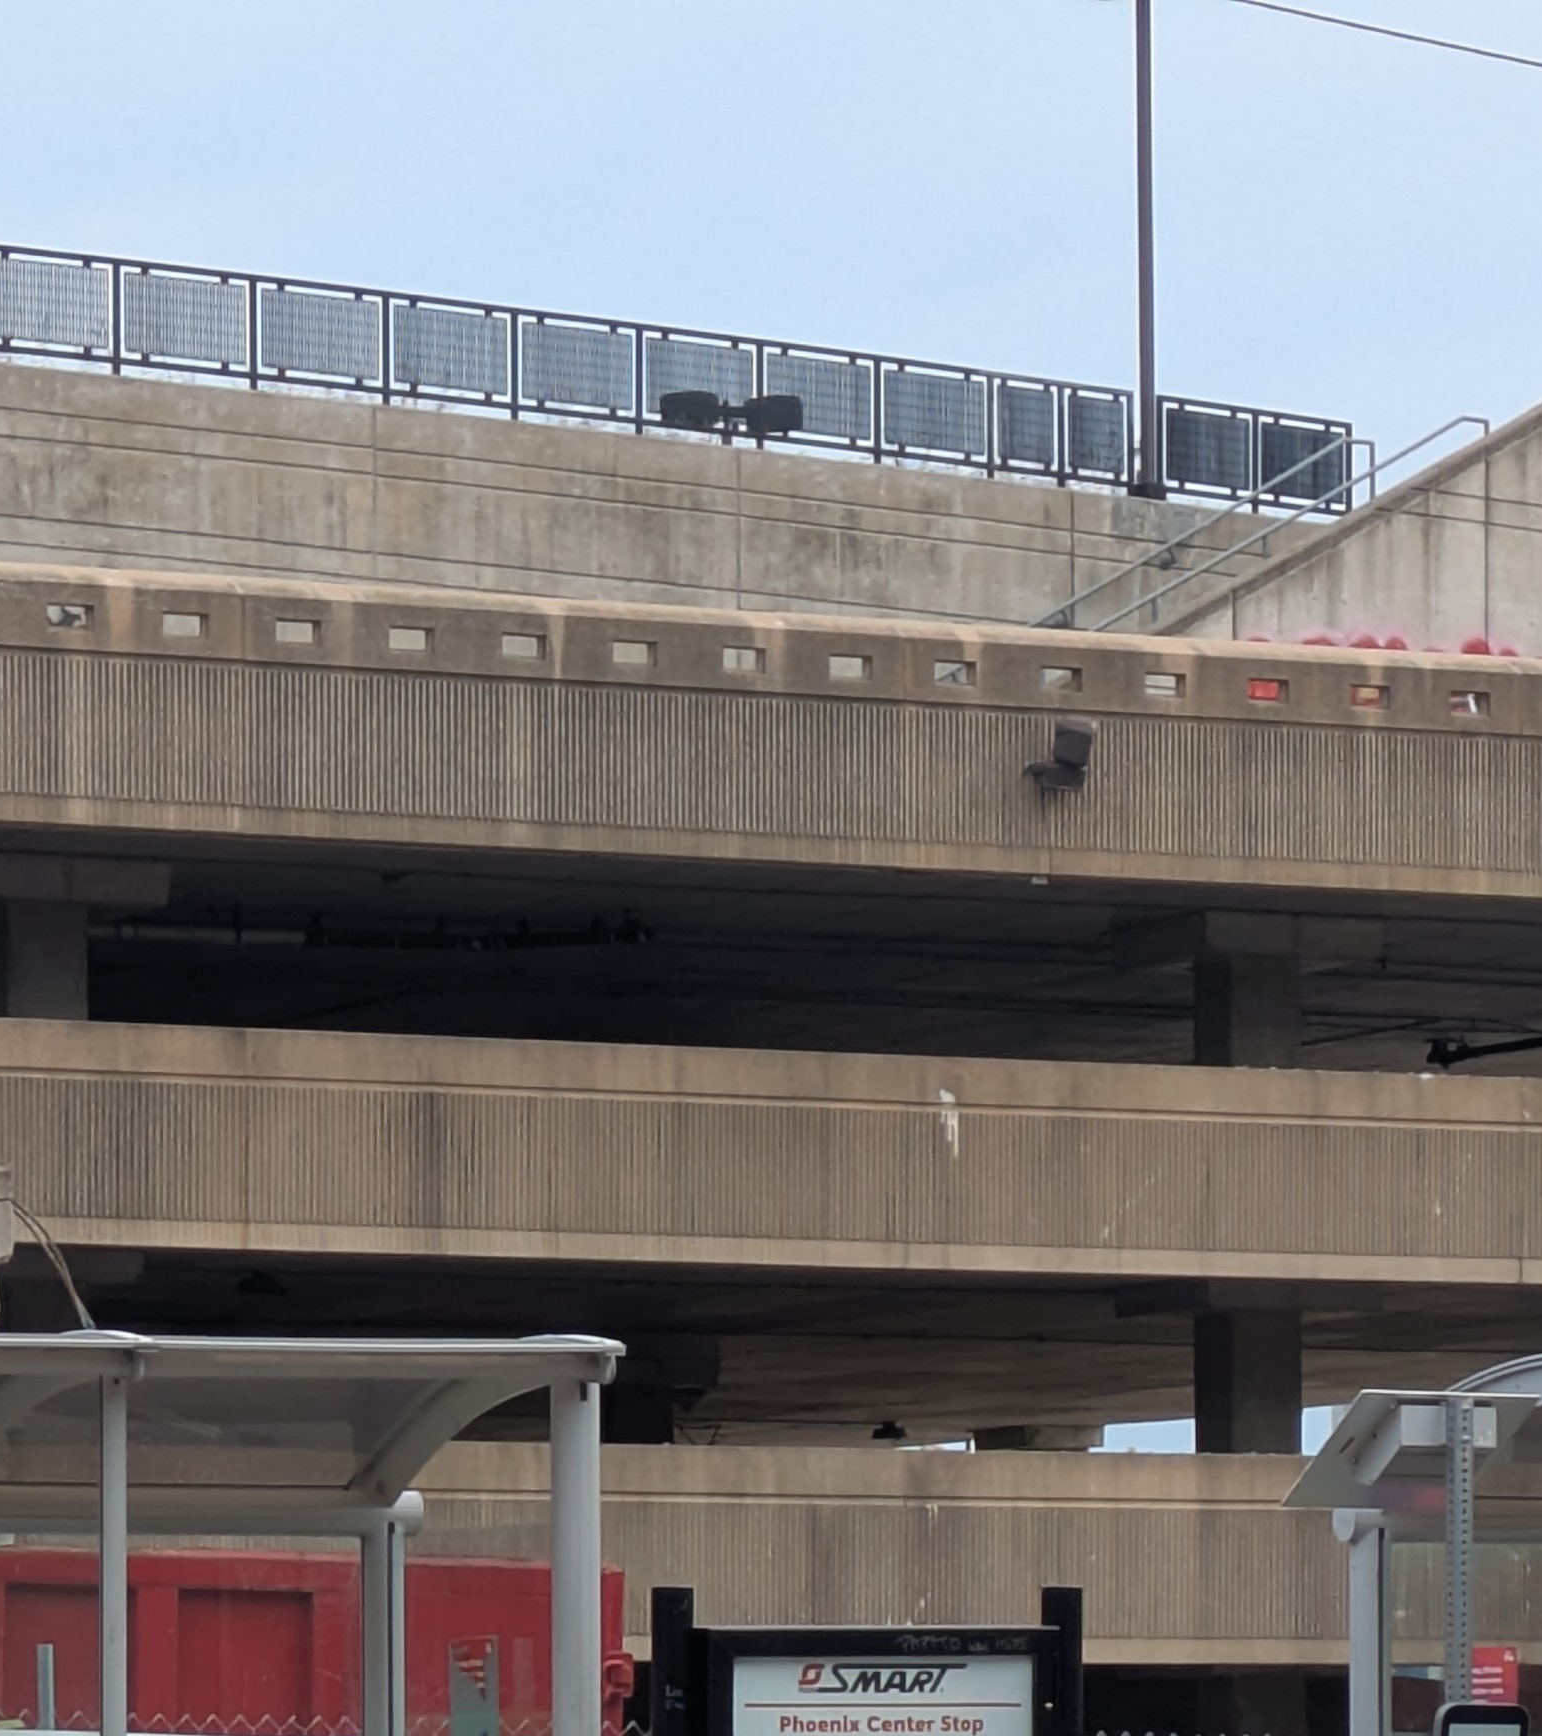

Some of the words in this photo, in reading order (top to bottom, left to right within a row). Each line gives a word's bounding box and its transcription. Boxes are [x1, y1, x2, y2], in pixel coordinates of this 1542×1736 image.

[817, 1662, 968, 1694] SMART
[779, 1715, 860, 1733] Phoenix
[867, 1715, 935, 1732] Center
[940, 1715, 984, 1736] Stop
